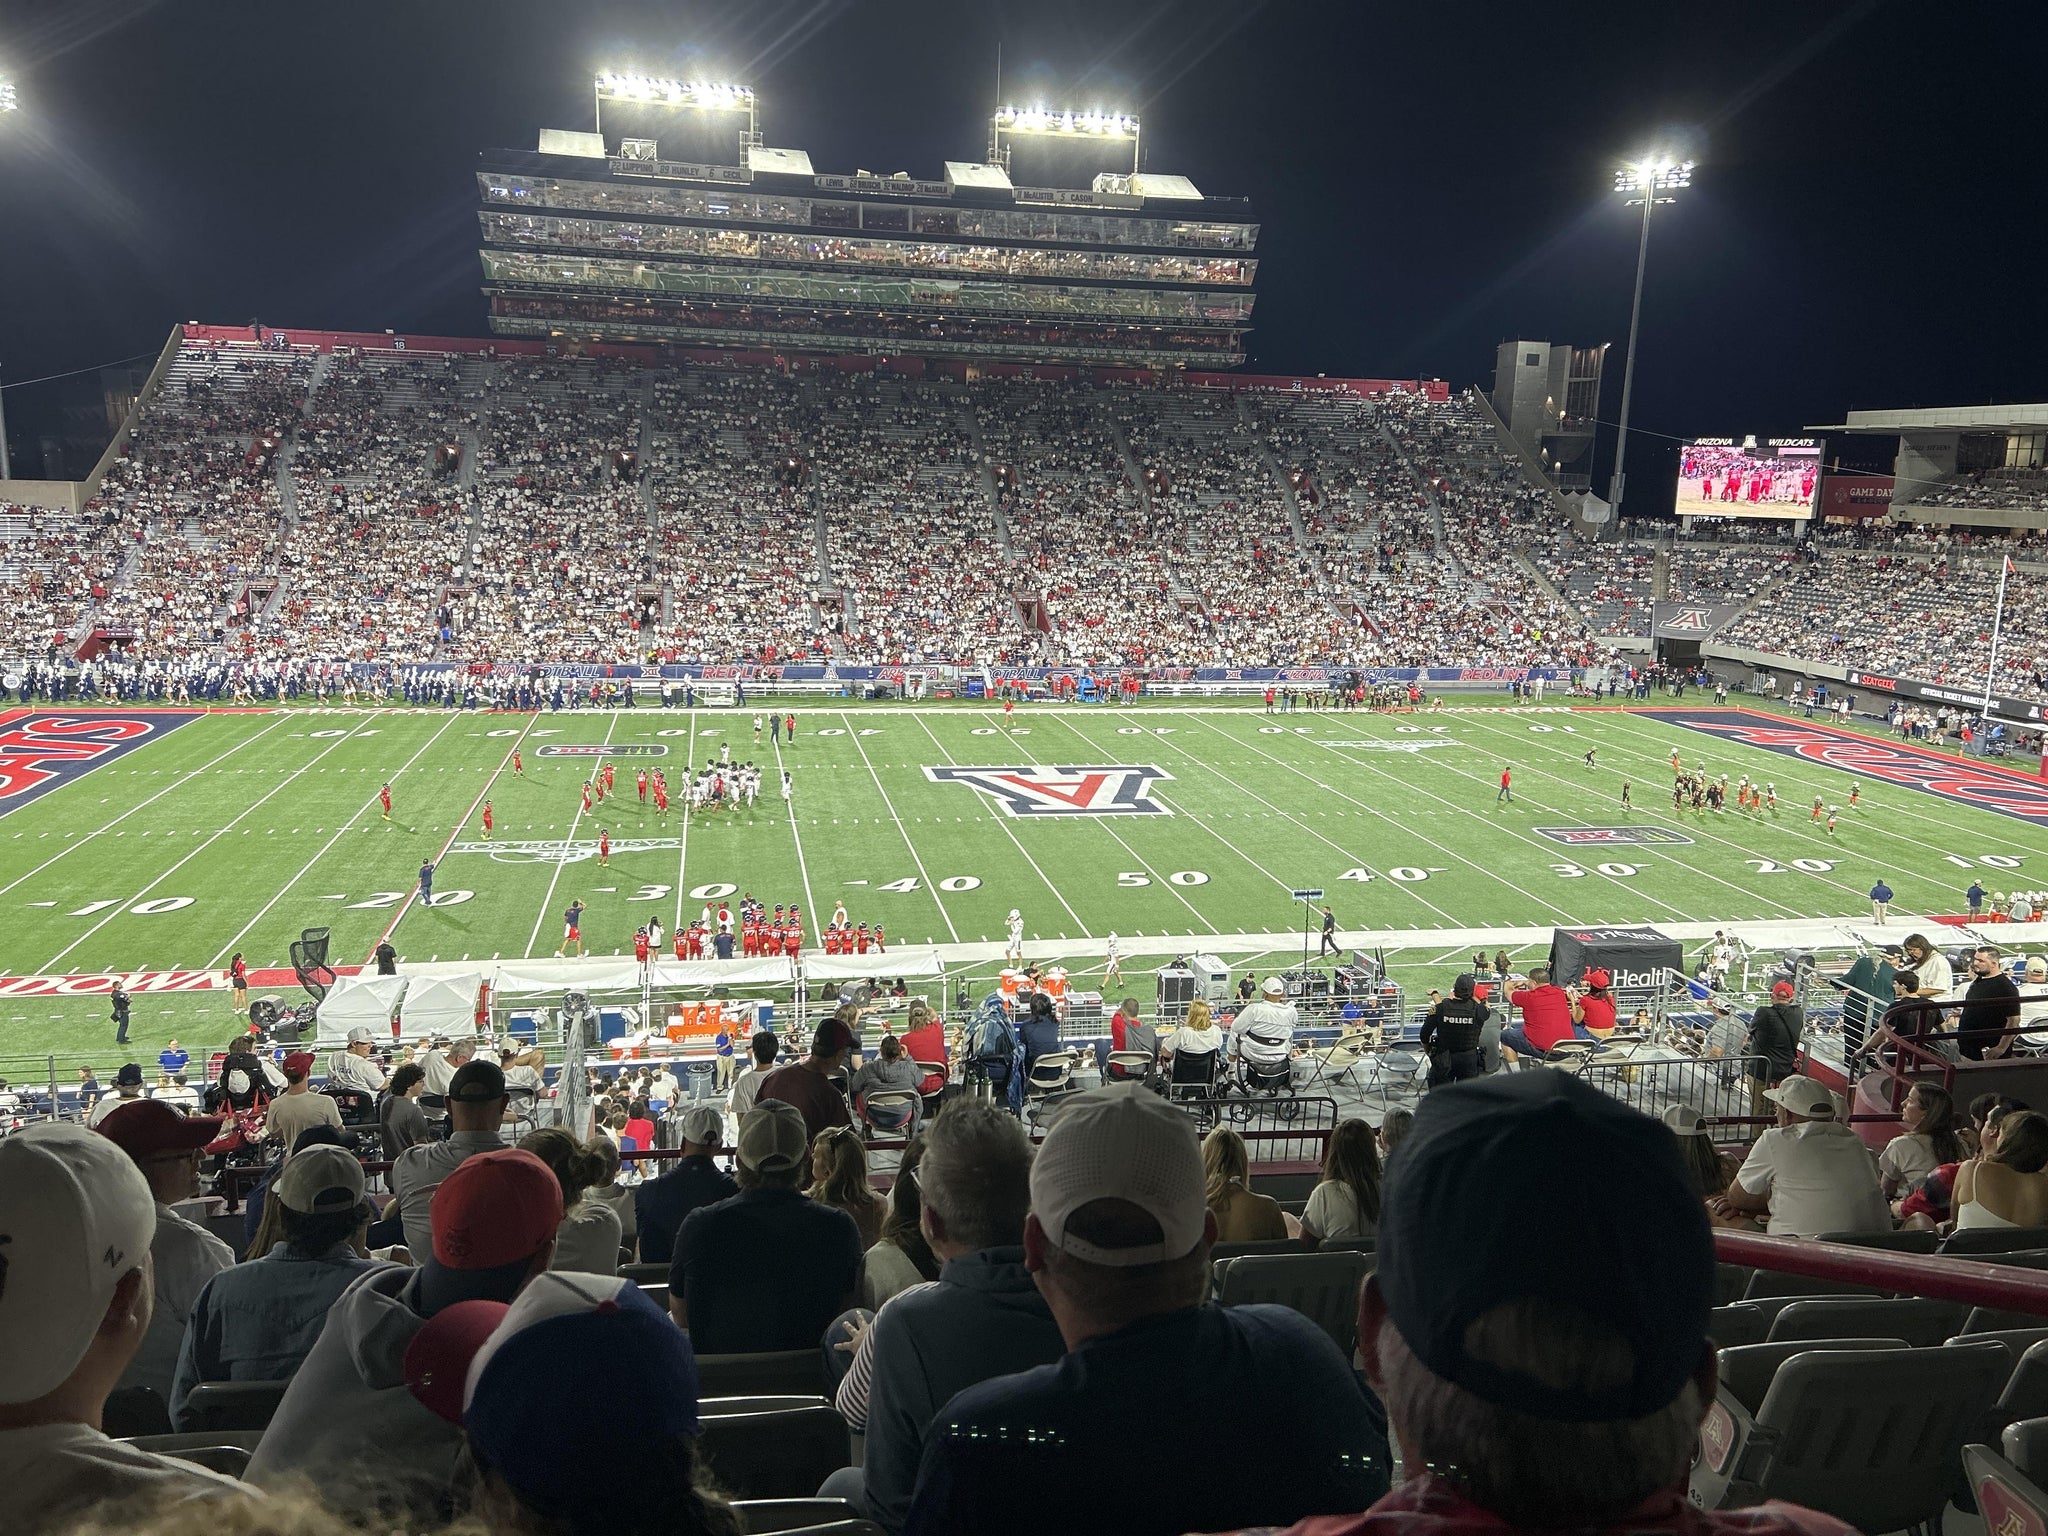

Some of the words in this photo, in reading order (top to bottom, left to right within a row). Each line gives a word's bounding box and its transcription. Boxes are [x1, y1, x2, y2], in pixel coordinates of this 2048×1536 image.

[672, 166, 699, 176] HUNLEY
[1071, 194, 1093, 203] CASON
[395, 342, 405, 350] 18
[810, 361, 820, 369] 21
[1695, 438, 1733, 446] ARIZONA
[1769, 438, 1815, 447] WILDCATS
[1850, 488, 1874, 497] GAME
[1877, 489, 1894, 497] DAY
[1861, 674, 1896, 690] SEATGEEK
[1920, 687, 1943, 698] OFFICIAL
[454, 842, 507, 850] SOL
[1745, 858, 1834, 873] 20
[1942, 855, 2025, 868] 10
[1336, 866, 1430, 882] 40
[1549, 862, 1638, 878] 30
[876, 876, 983, 893] 40
[1117, 870, 1211, 887] 50
[626, 883, 739, 901] 30
[66, 897, 198, 916] 10
[344, 890, 476, 910] 20
[2, 970, 257, 993] DOWN
[1613, 966, 1674, 987] Health
[1443, 1016, 1473, 1025] POLICE
